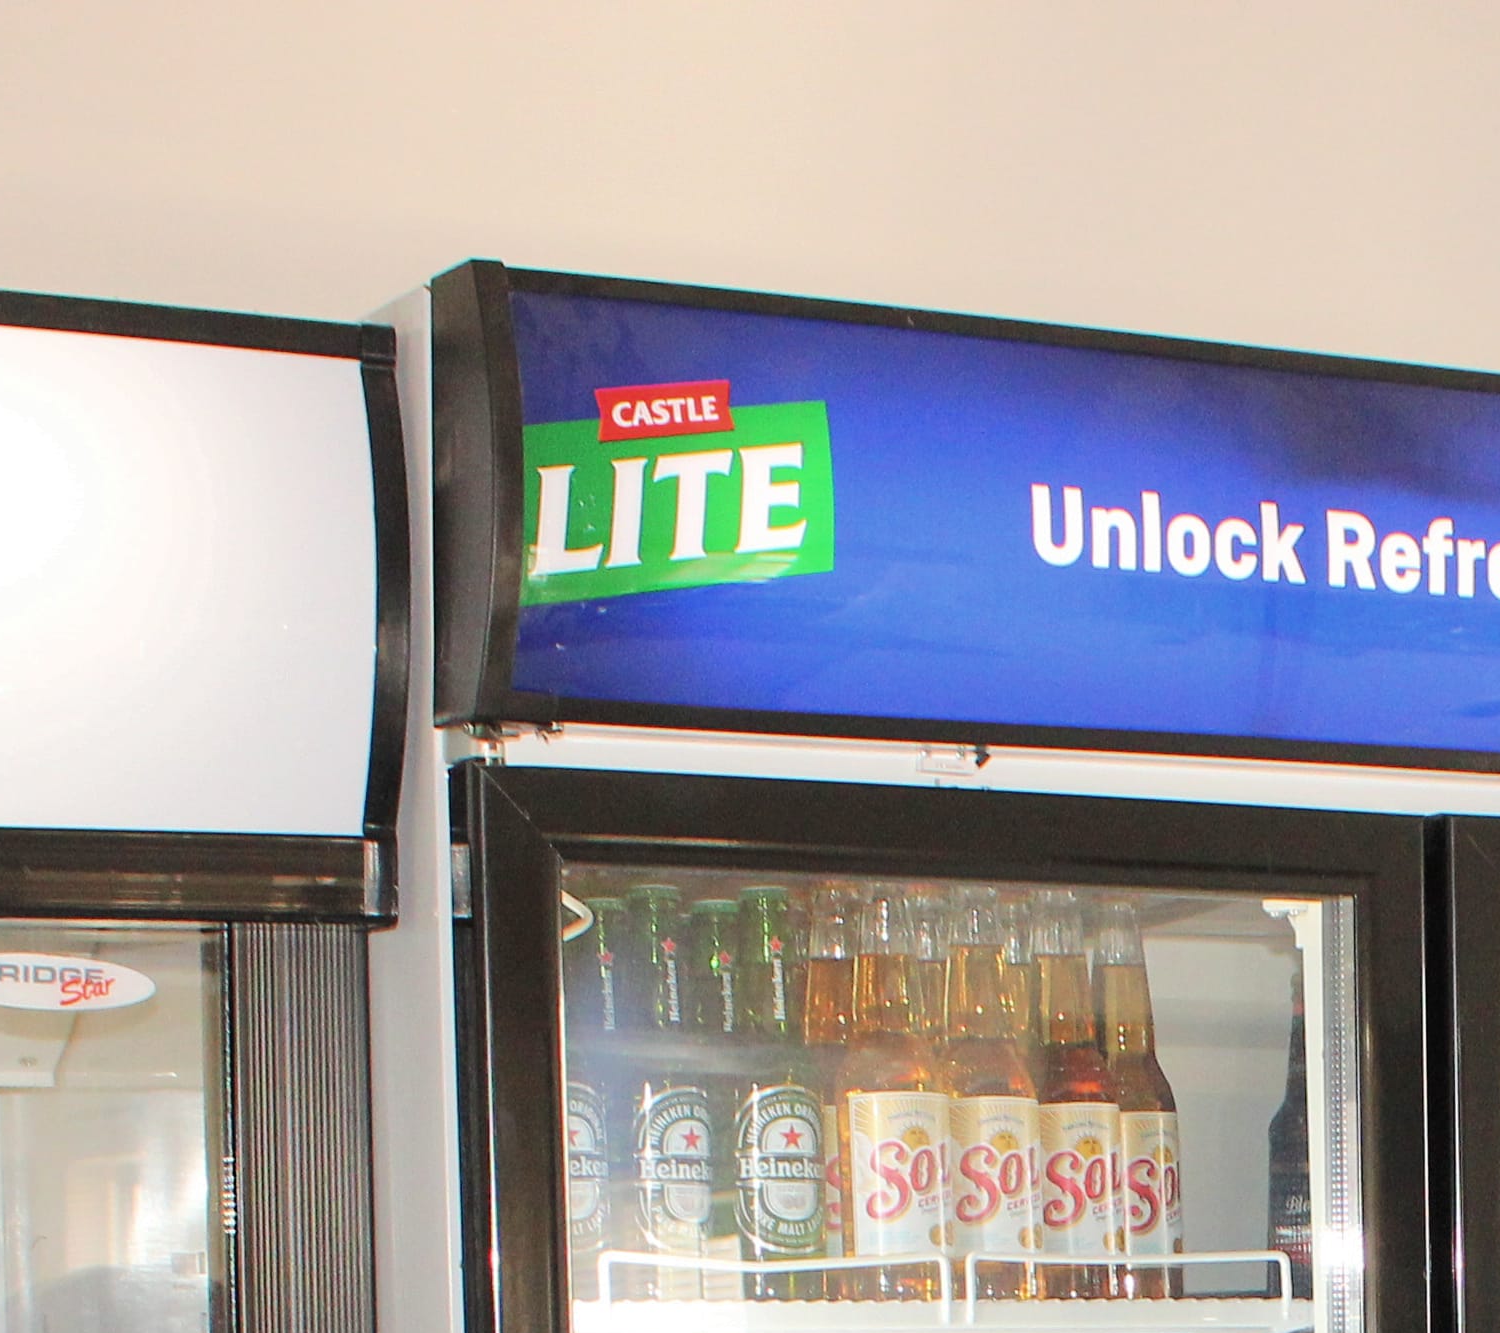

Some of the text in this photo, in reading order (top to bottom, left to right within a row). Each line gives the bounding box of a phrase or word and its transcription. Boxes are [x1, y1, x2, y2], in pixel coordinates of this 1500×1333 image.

[611, 395, 720, 429] CASTLE
[527, 441, 808, 577] LITE
[1031, 483, 1306, 584] Unlock
[60, 976, 116, 1006] Star
